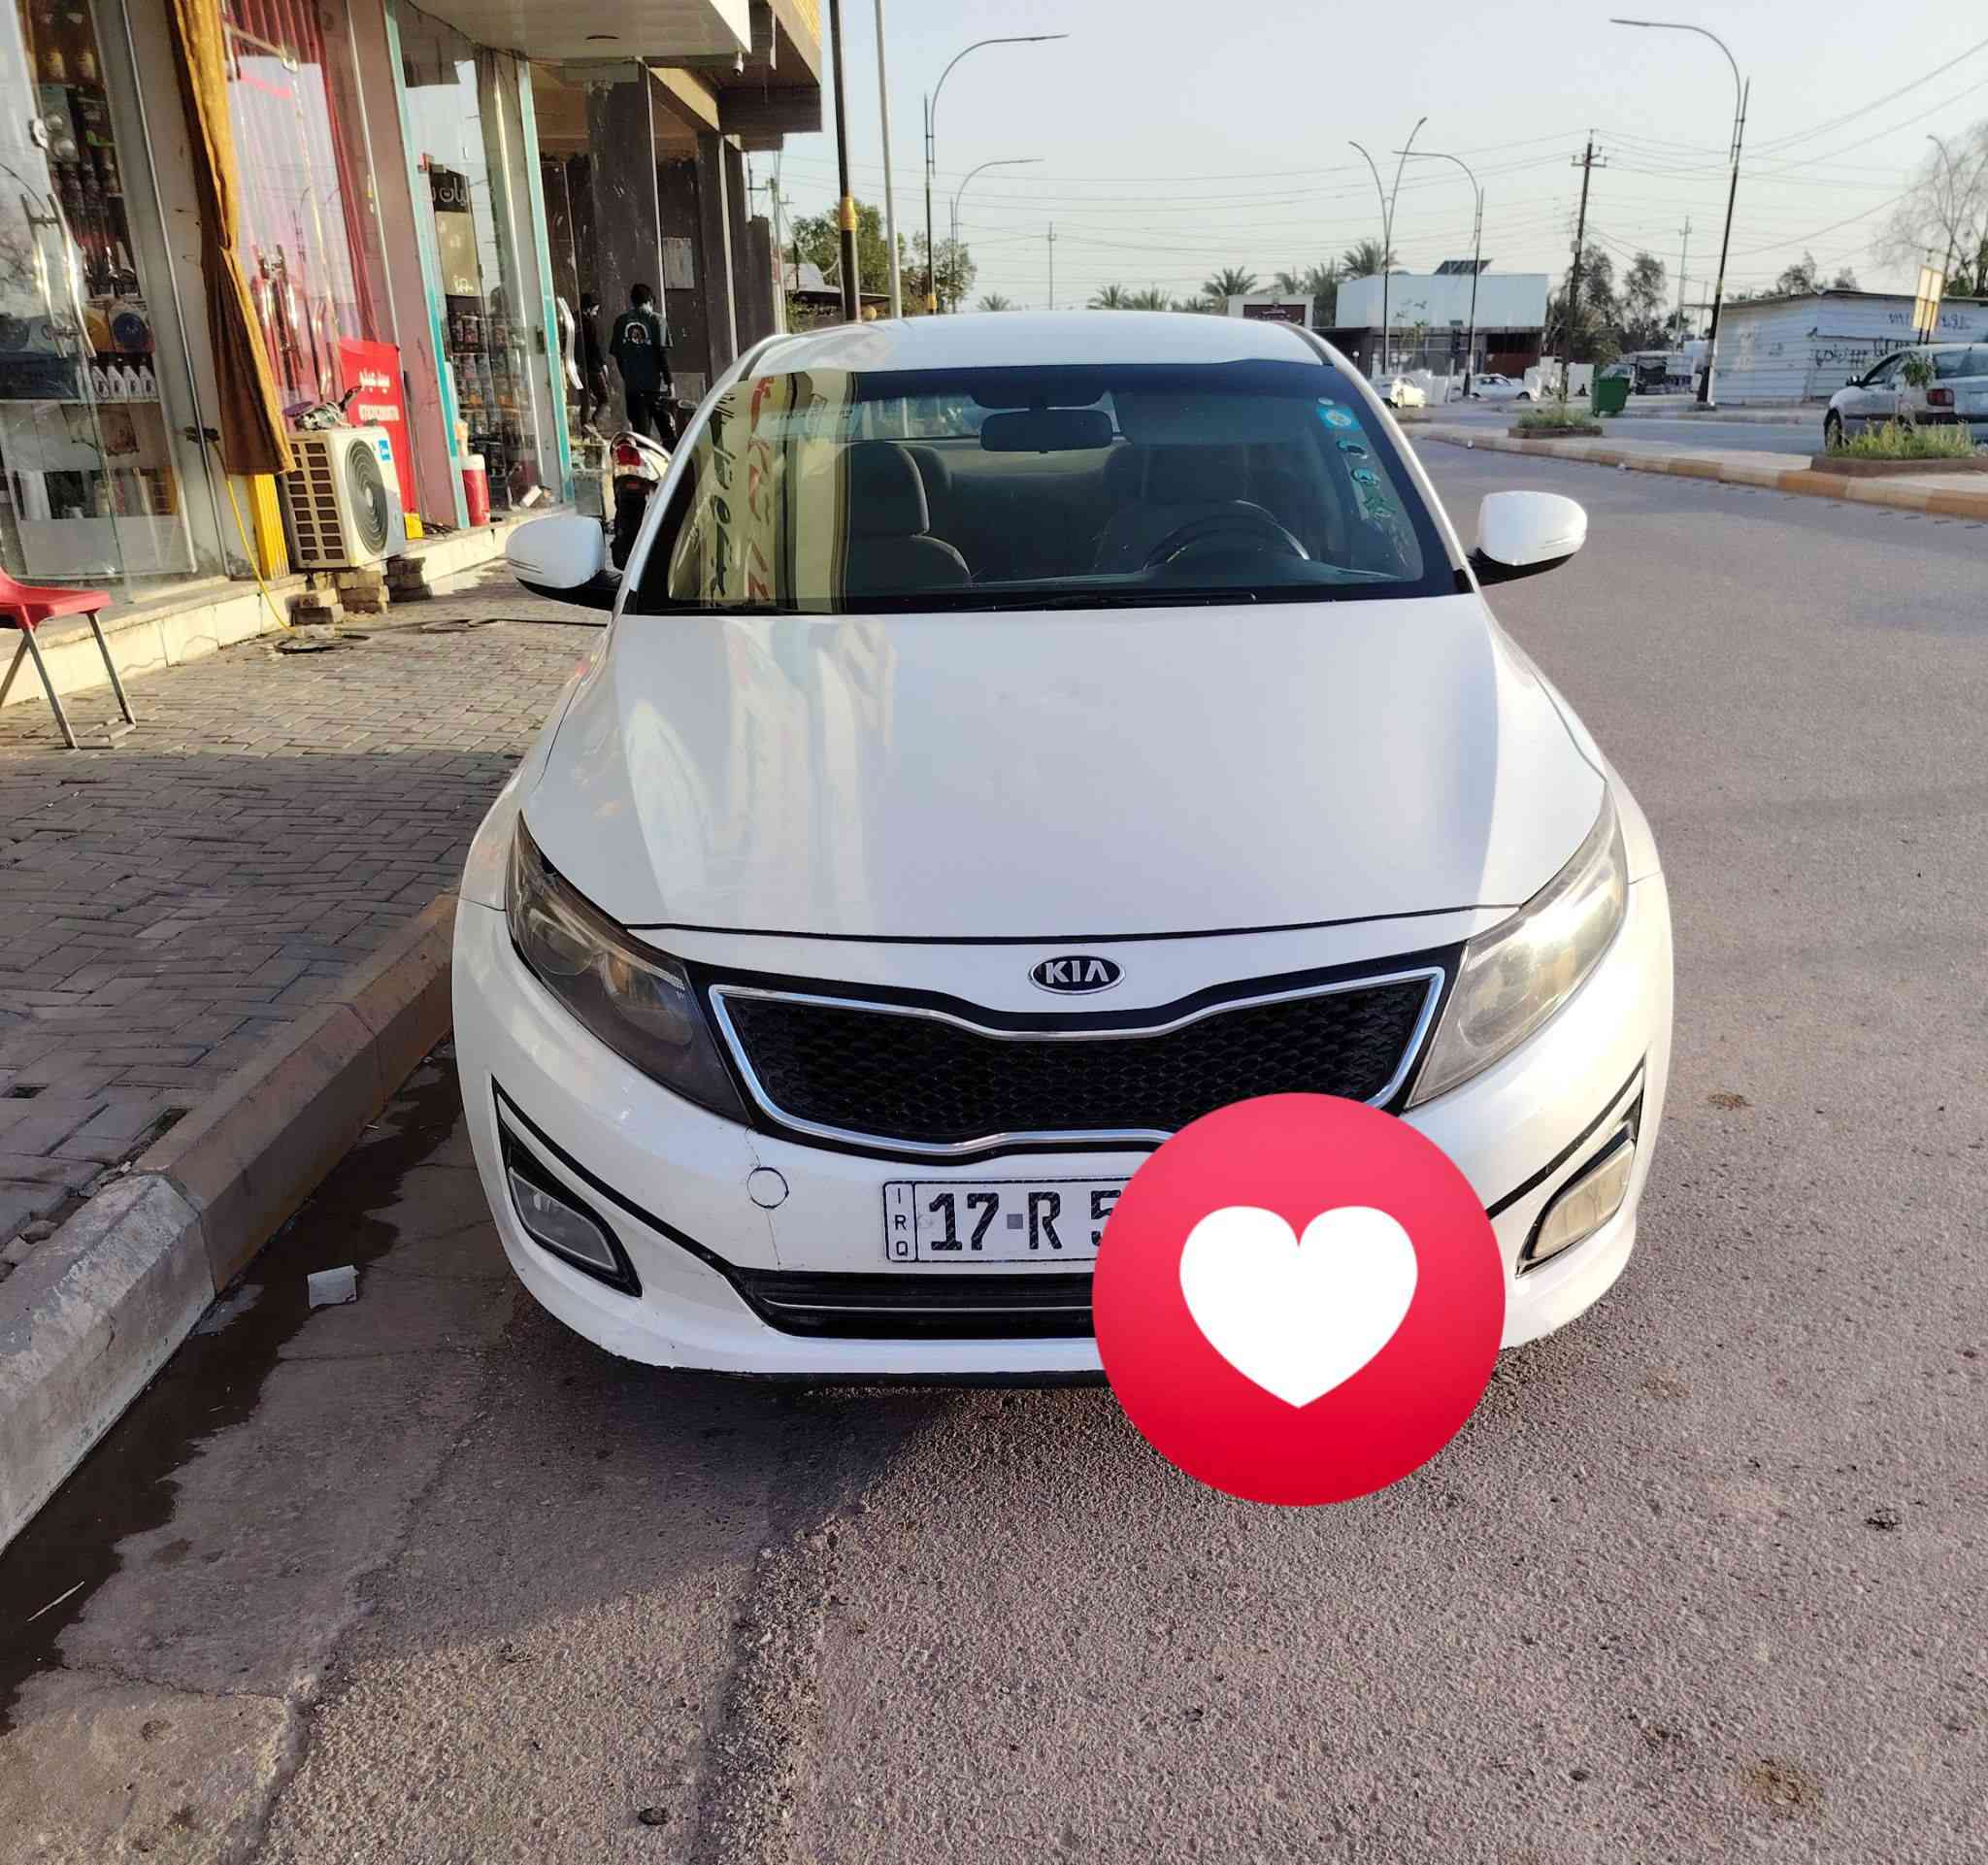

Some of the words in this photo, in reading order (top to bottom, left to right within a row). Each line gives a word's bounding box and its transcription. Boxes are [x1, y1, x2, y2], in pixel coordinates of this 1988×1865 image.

[1044, 960, 1110, 983] KIA
[894, 1188, 909, 1257] IRQ
[929, 1192, 1000, 1251] 17
[1027, 1191, 1063, 1250] R
